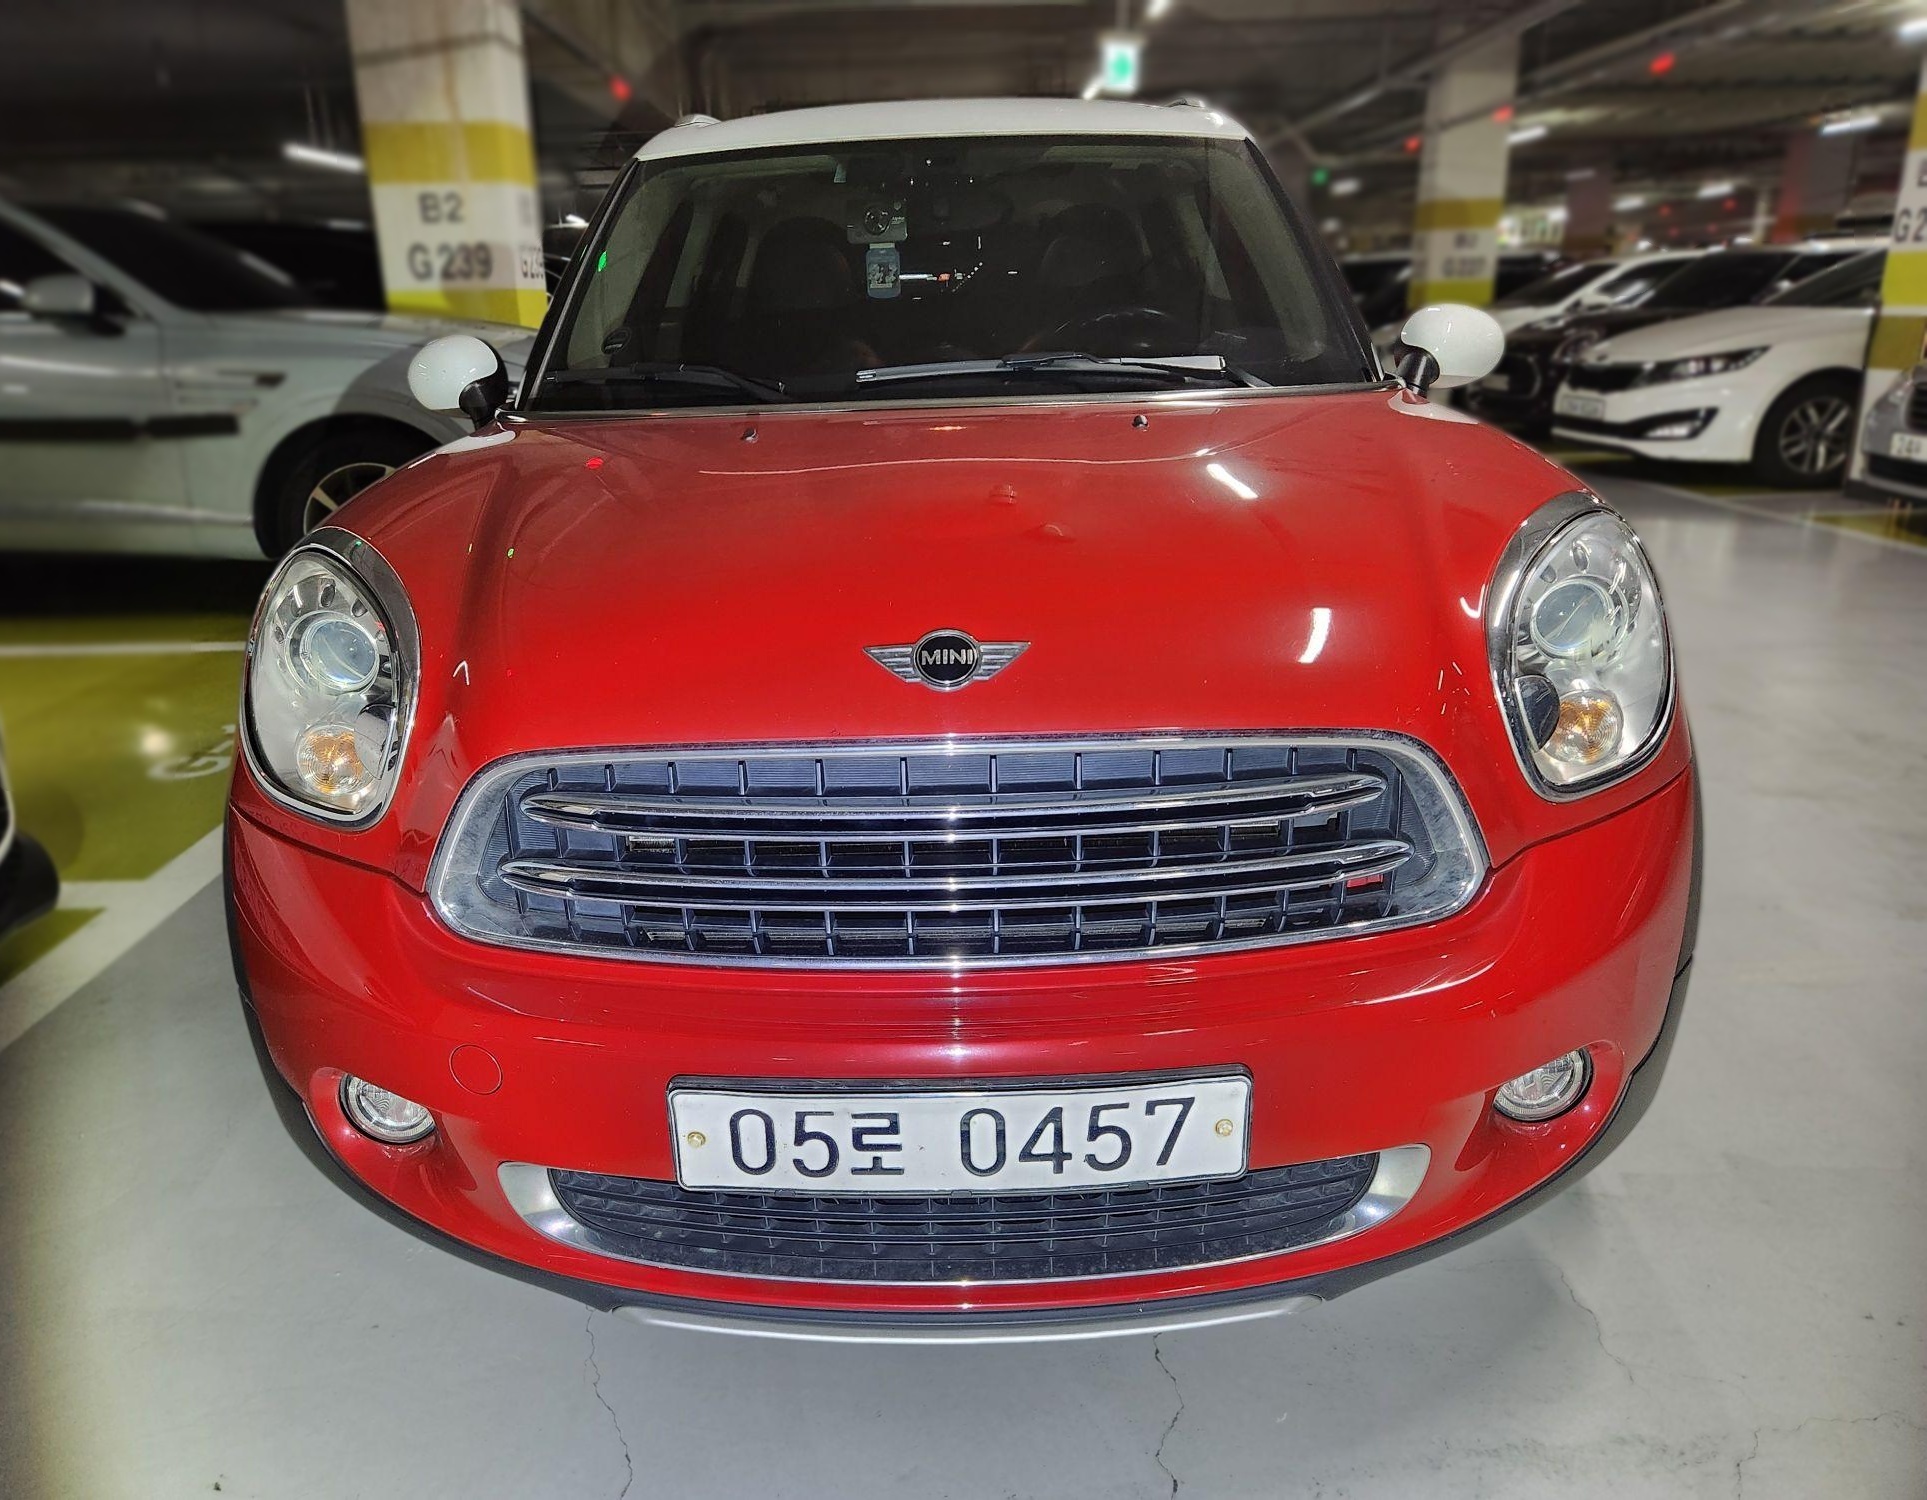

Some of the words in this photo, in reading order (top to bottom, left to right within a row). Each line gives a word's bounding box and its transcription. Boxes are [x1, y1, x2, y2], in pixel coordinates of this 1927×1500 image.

[417, 191, 465, 224] B2
[921, 648, 974, 666] MINI
[728, 1107, 905, 1178] 05로
[959, 1096, 1196, 1178] 0457
